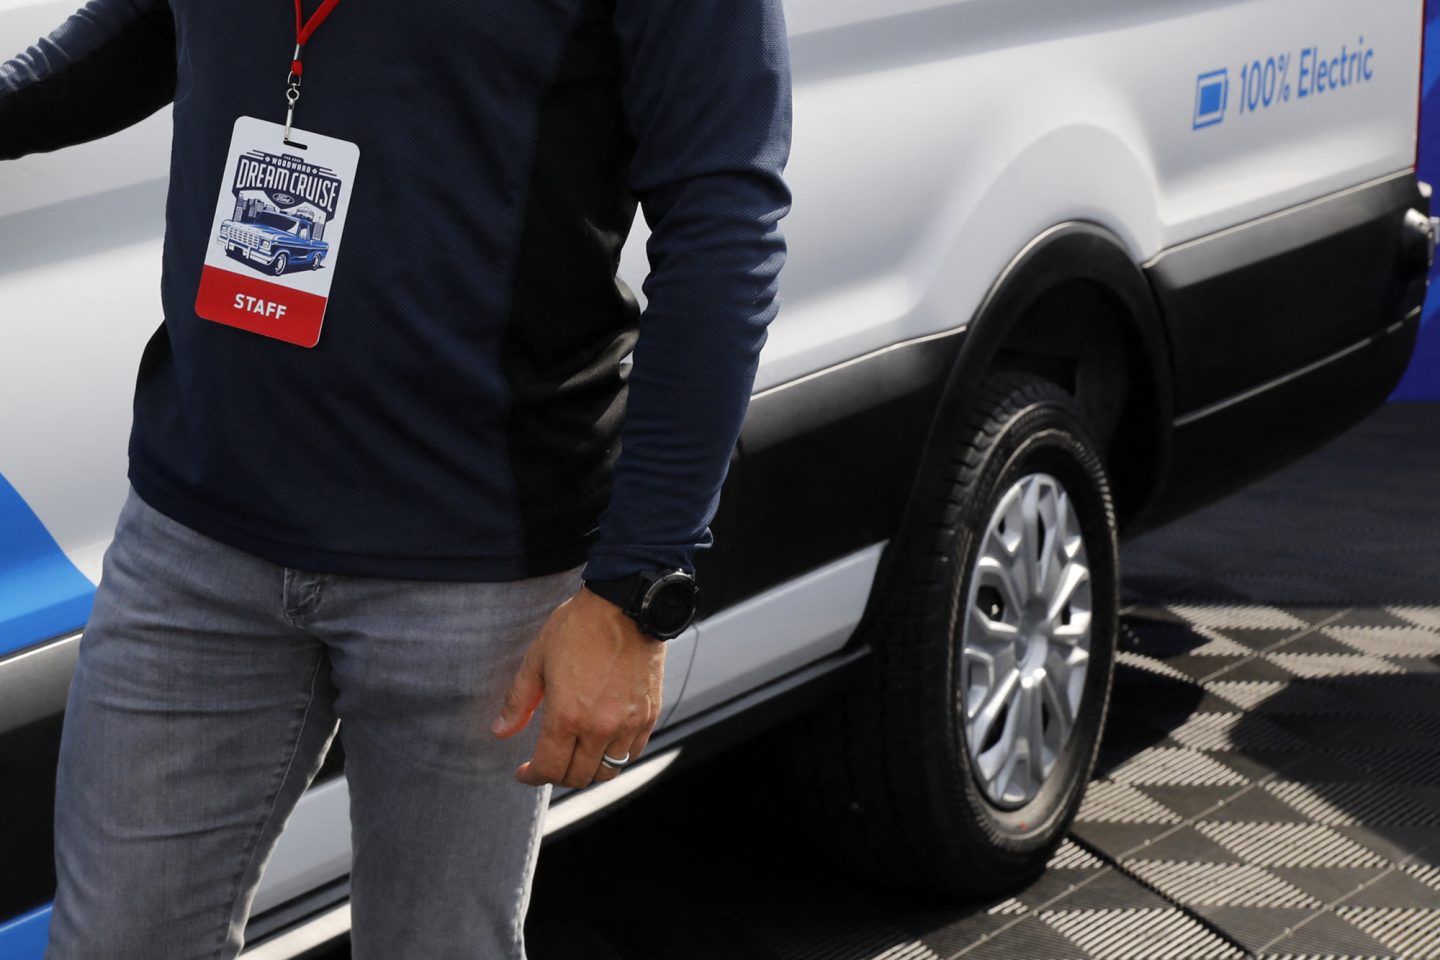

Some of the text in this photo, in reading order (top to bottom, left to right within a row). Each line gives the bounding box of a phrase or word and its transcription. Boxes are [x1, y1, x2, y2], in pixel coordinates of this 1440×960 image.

[1239, 34, 1375, 115] 100% Electric
[236, 158, 338, 213] DREAM CRUISE
[272, 157, 311, 174] WOODWARD
[233, 292, 287, 320] STAFF
